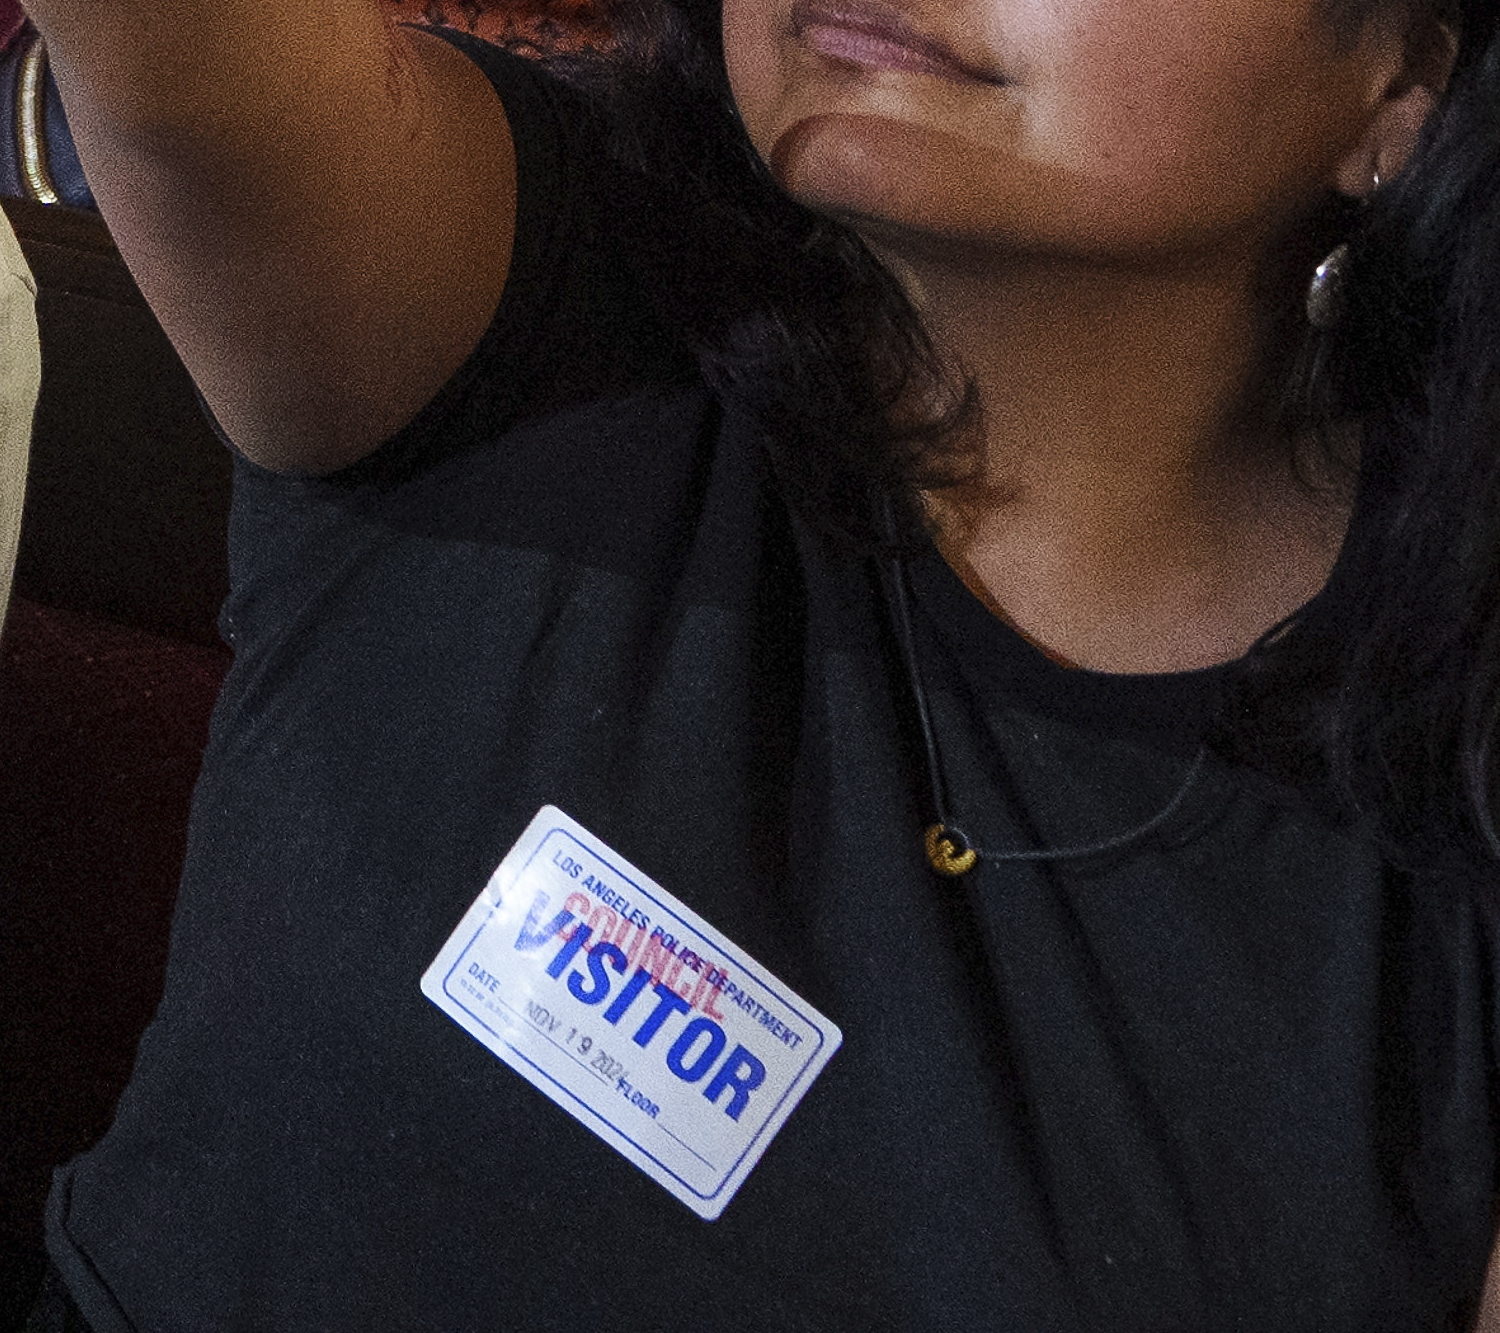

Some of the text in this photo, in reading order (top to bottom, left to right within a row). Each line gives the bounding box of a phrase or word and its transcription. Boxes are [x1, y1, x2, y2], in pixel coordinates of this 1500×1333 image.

[552, 849, 584, 879] LOS
[581, 875, 651, 931] ANGELES
[557, 891, 725, 1023] COUNCIL
[468, 962, 501, 993] DATE
[615, 1076, 660, 1120] FLOOR
[513, 888, 768, 1123] VISITOR
